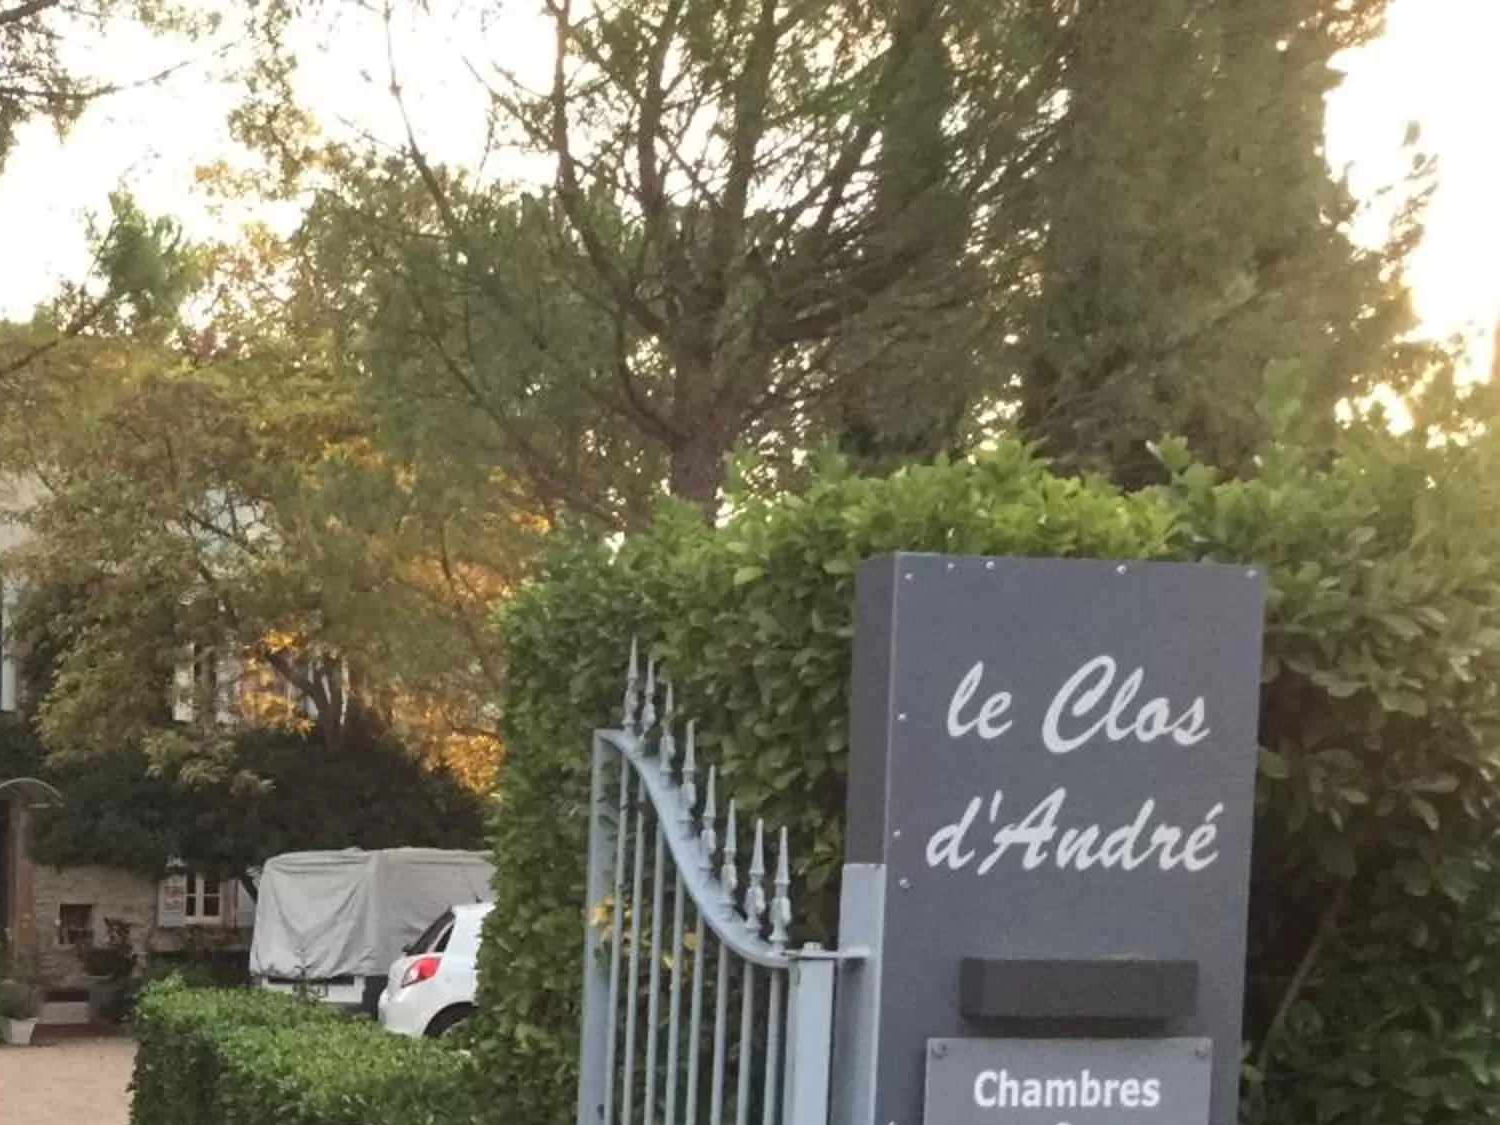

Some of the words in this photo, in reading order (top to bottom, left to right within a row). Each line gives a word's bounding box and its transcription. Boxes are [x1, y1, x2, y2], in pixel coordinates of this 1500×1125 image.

[946, 660, 1013, 740] le
[1041, 654, 1211, 754] Clos
[925, 786, 1224, 876] d'André
[973, 1068, 1162, 1108] Chambres
